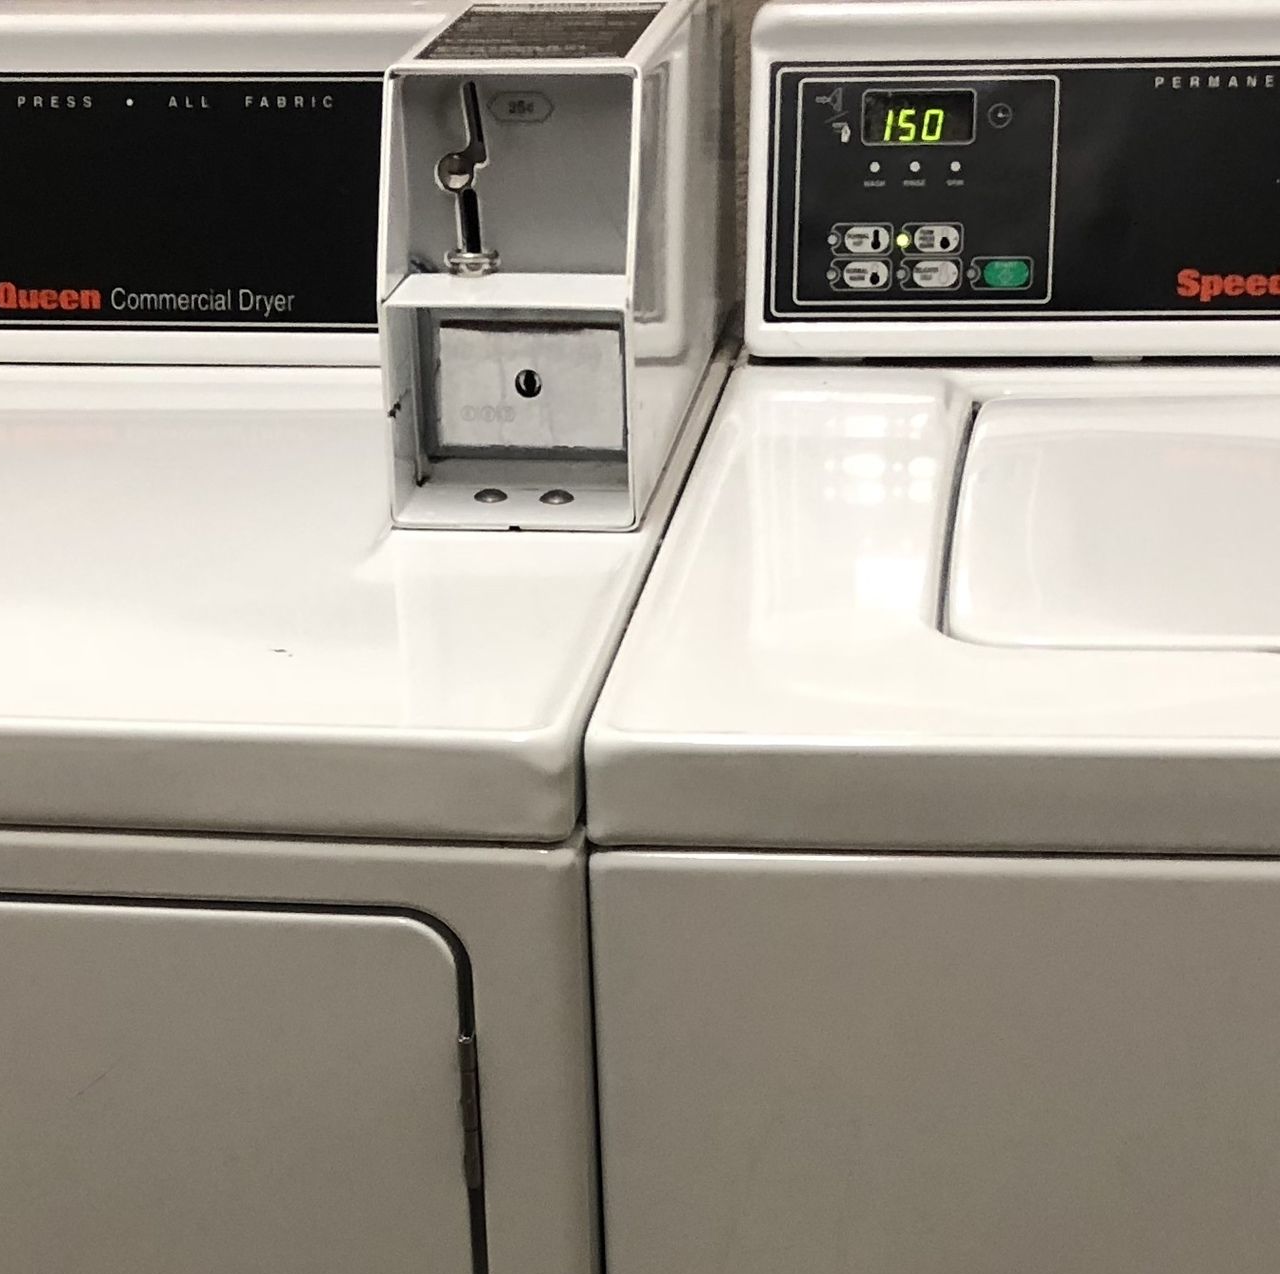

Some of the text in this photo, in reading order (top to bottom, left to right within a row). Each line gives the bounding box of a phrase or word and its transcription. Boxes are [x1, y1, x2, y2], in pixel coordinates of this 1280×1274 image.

[16, 95, 93, 108] PRESS
[167, 95, 210, 108] ALL
[244, 95, 333, 108] FABRIC
[884, 108, 945, 143] 150
[110, 286, 232, 312] Commercial
[237, 288, 296, 318] Dryer
